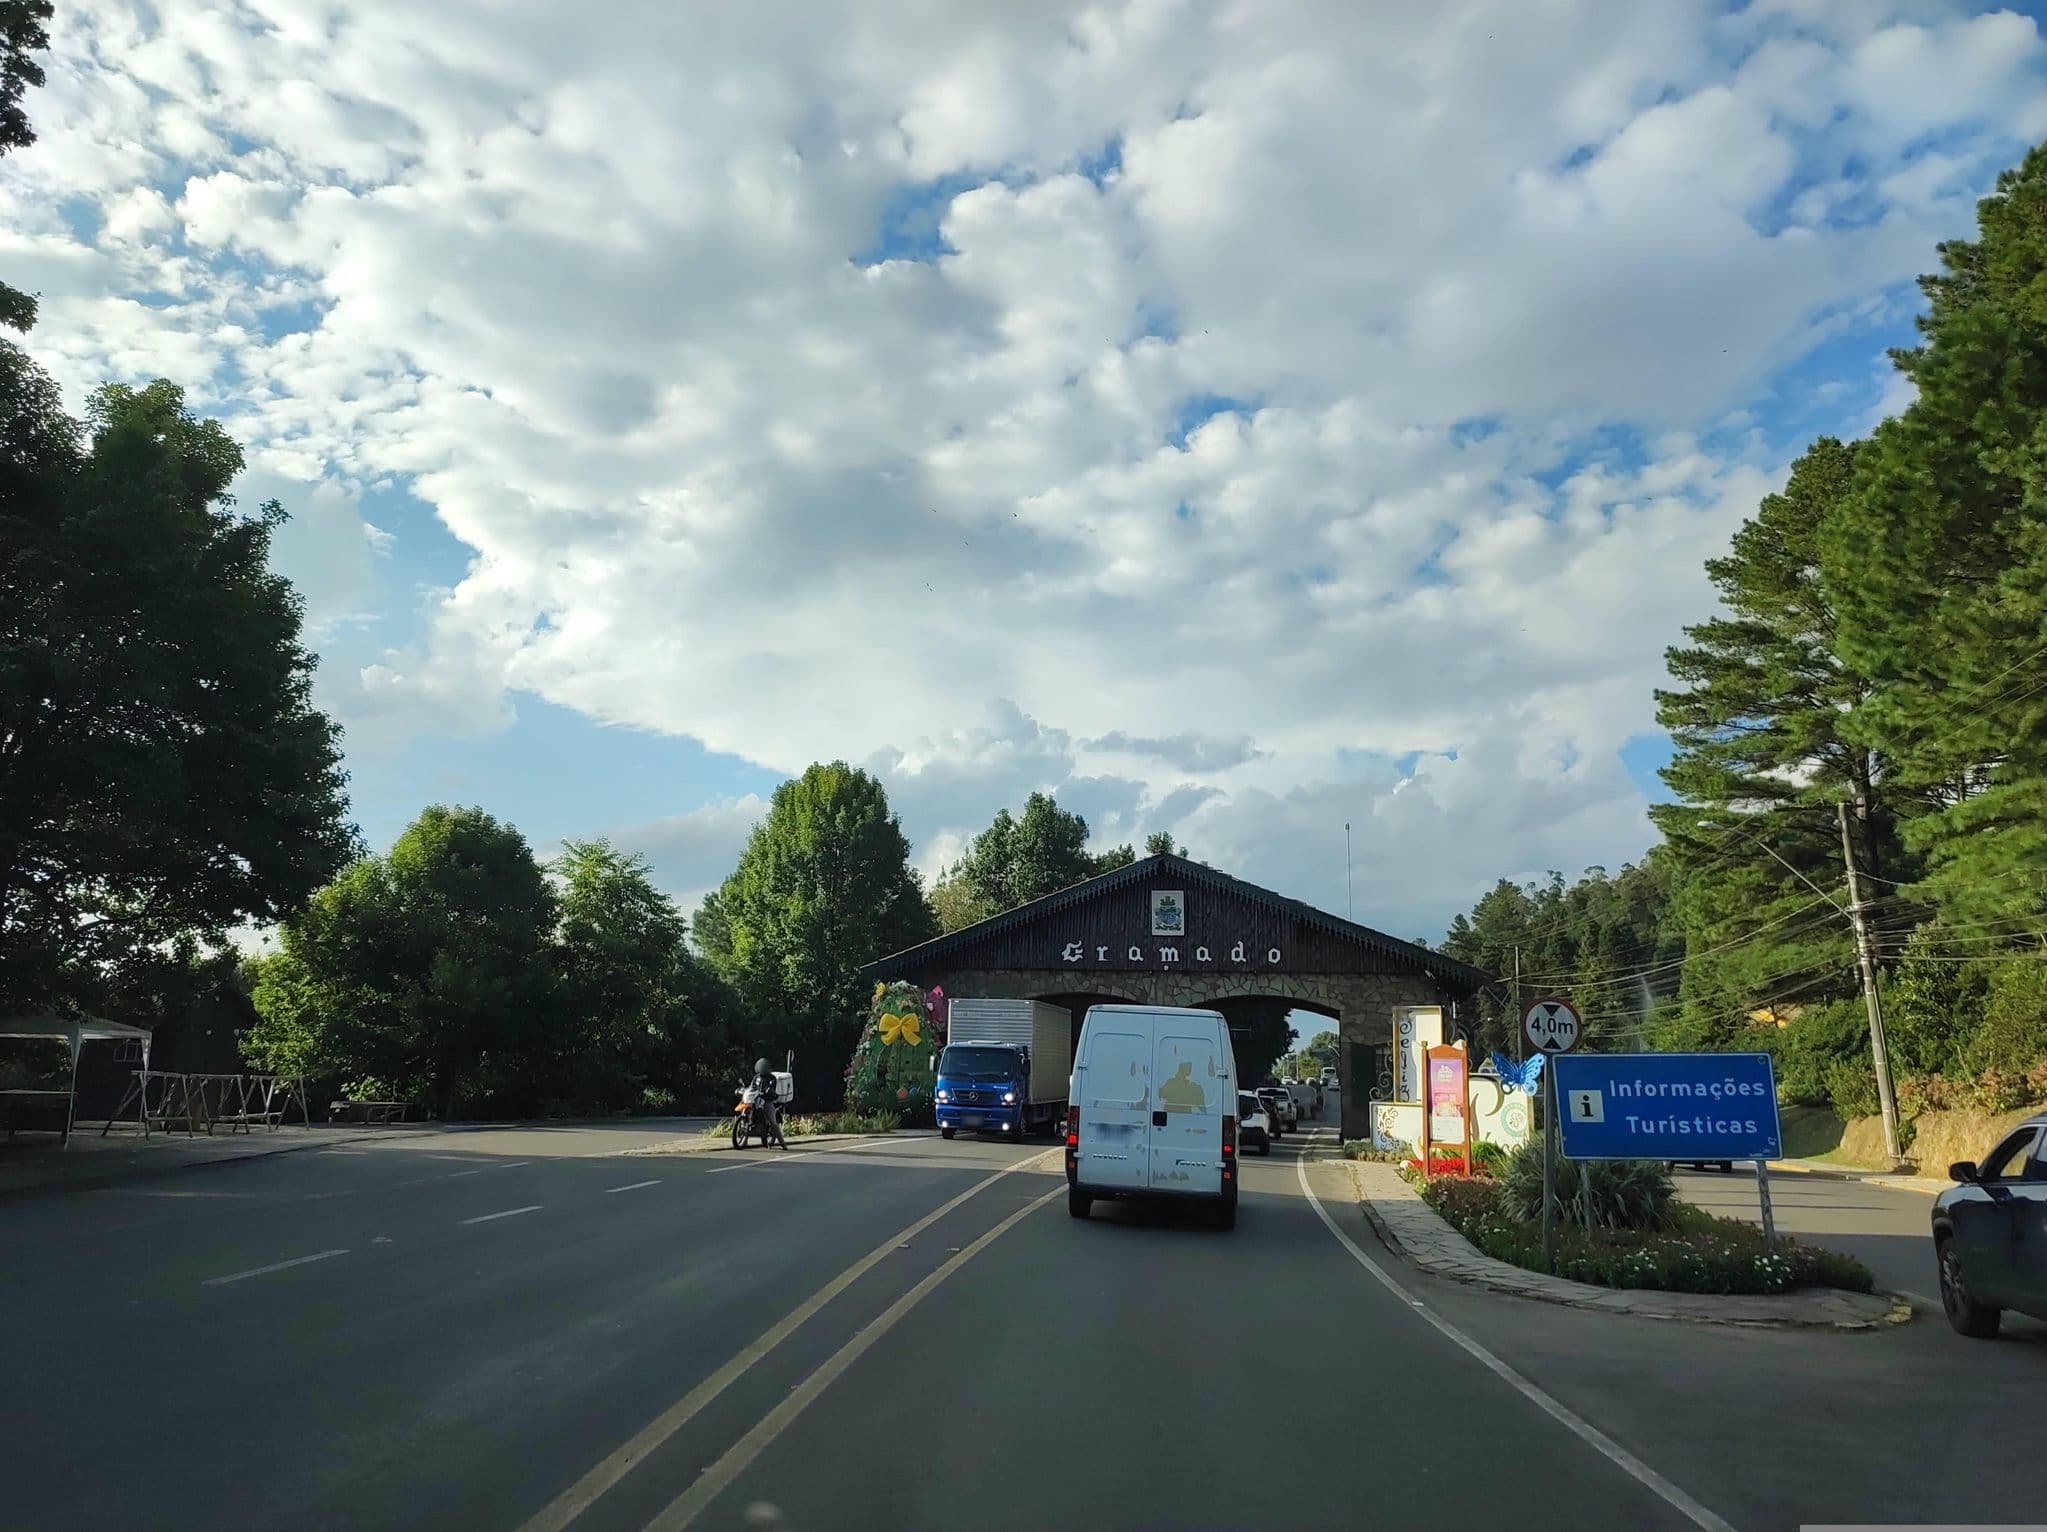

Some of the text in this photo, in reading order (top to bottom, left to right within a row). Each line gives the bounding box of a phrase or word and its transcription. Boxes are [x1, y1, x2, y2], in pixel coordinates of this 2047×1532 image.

[1062, 940, 1281, 964] Gramado
[1531, 1017, 1573, 1036] 4,0m
[1610, 1078, 1765, 1100] Informações
[1626, 1115, 1758, 1134] Turísticas
